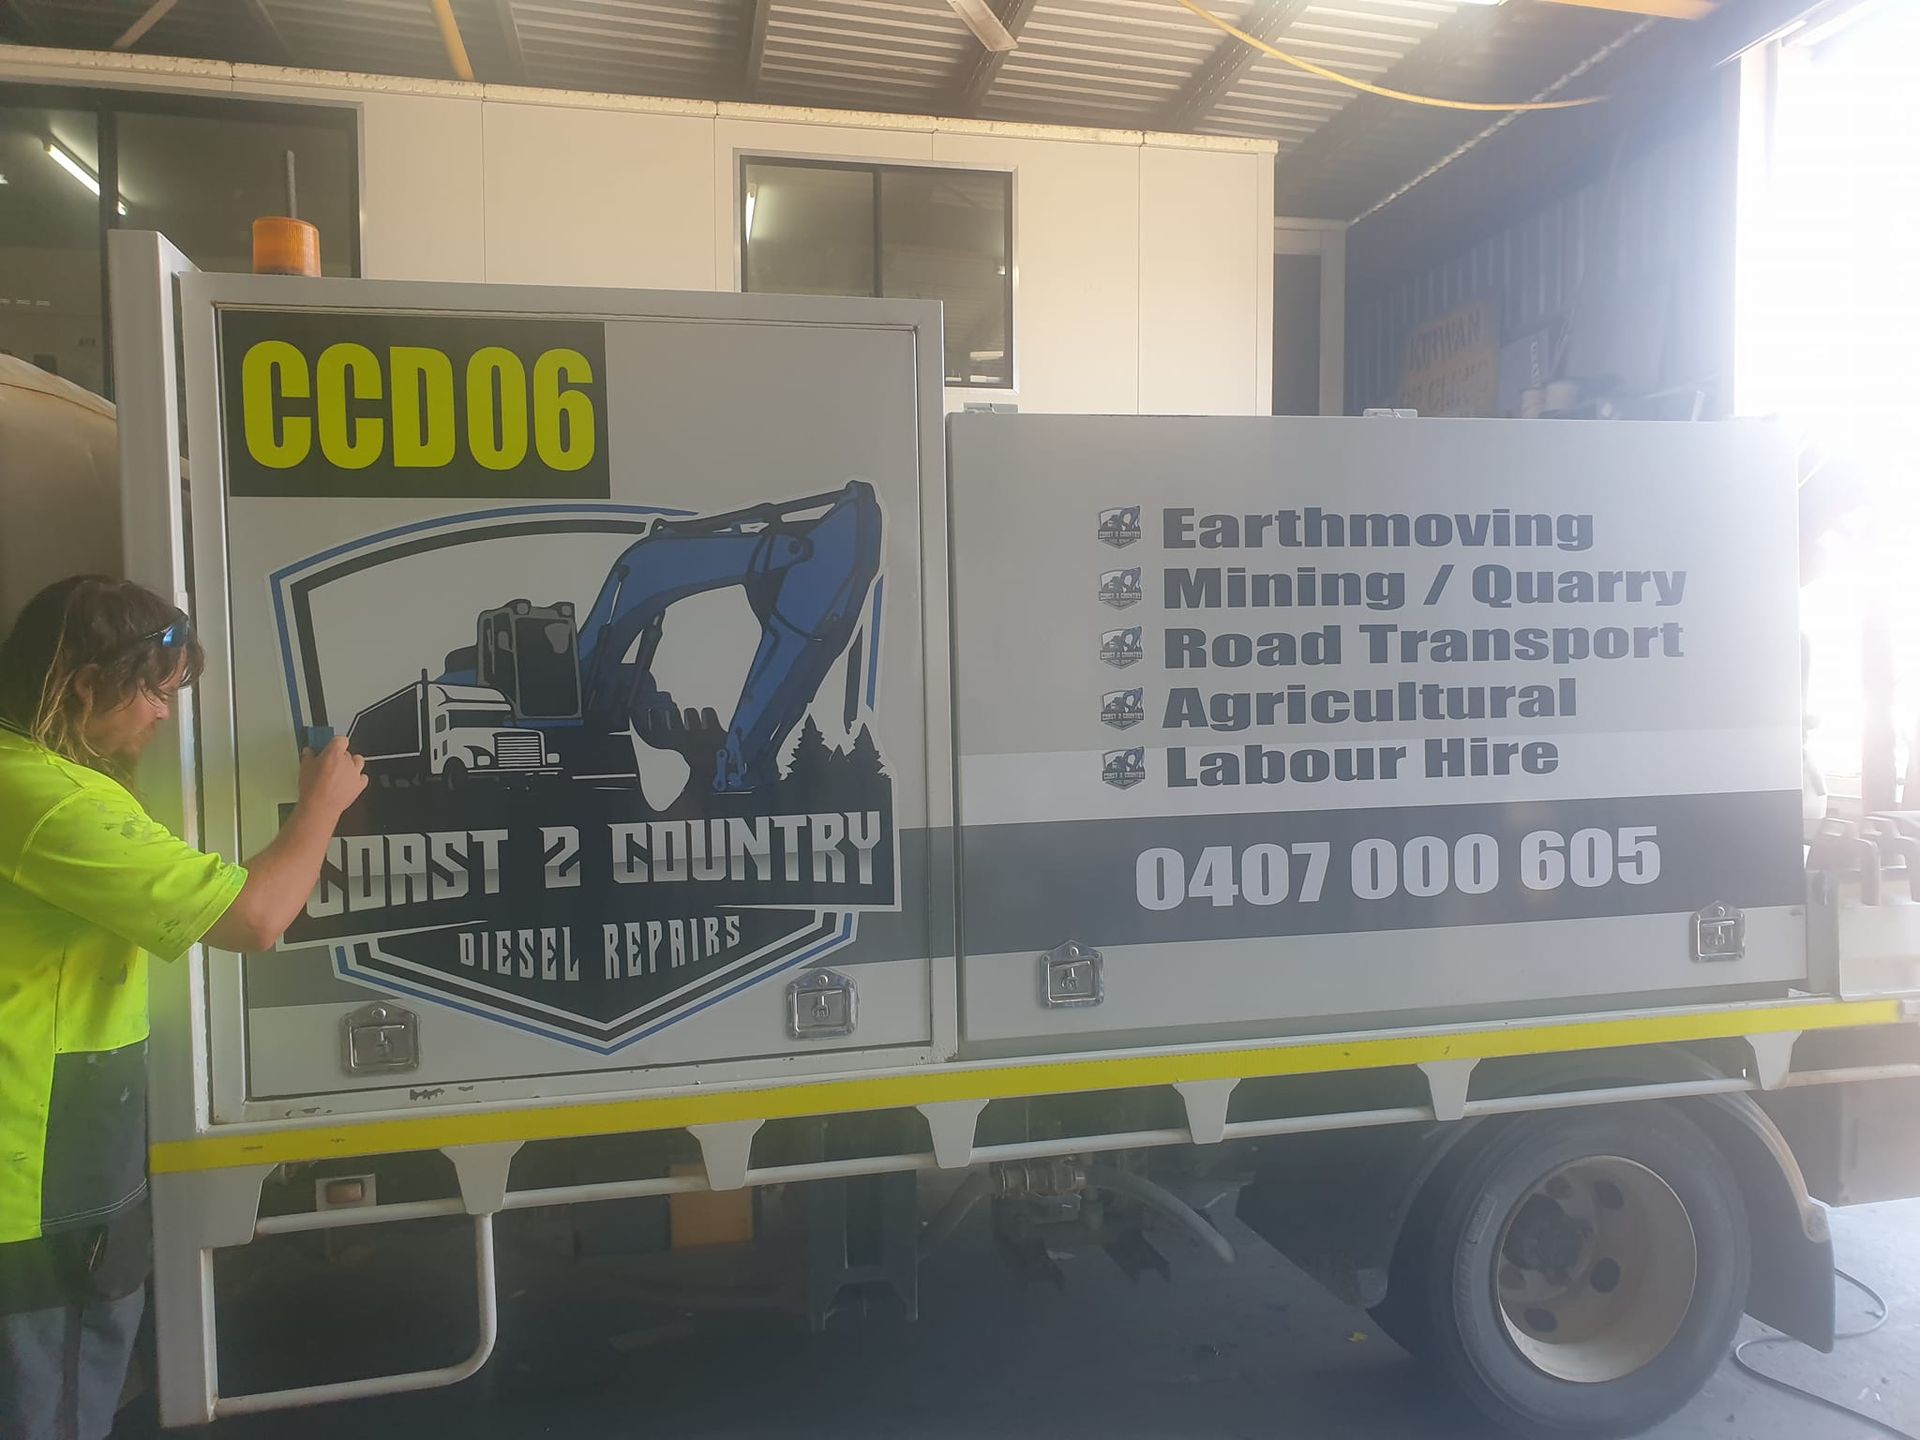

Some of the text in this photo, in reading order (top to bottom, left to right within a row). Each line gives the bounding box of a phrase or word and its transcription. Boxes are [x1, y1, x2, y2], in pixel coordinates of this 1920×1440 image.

[241, 340, 596, 472] CCD06
[1162, 507, 1594, 551] Earthmoving
[1162, 564, 1687, 611] Mining / Quarry
[1164, 621, 1685, 669] Road Transport
[1161, 678, 1577, 731] Agricultural
[1166, 737, 1559, 788] Labour Hire
[306, 811, 881, 919] COAST 2 COUNTRY
[1135, 826, 1661, 911] 0407 000 605
[458, 914, 742, 982] DIESEL REPAIRS
